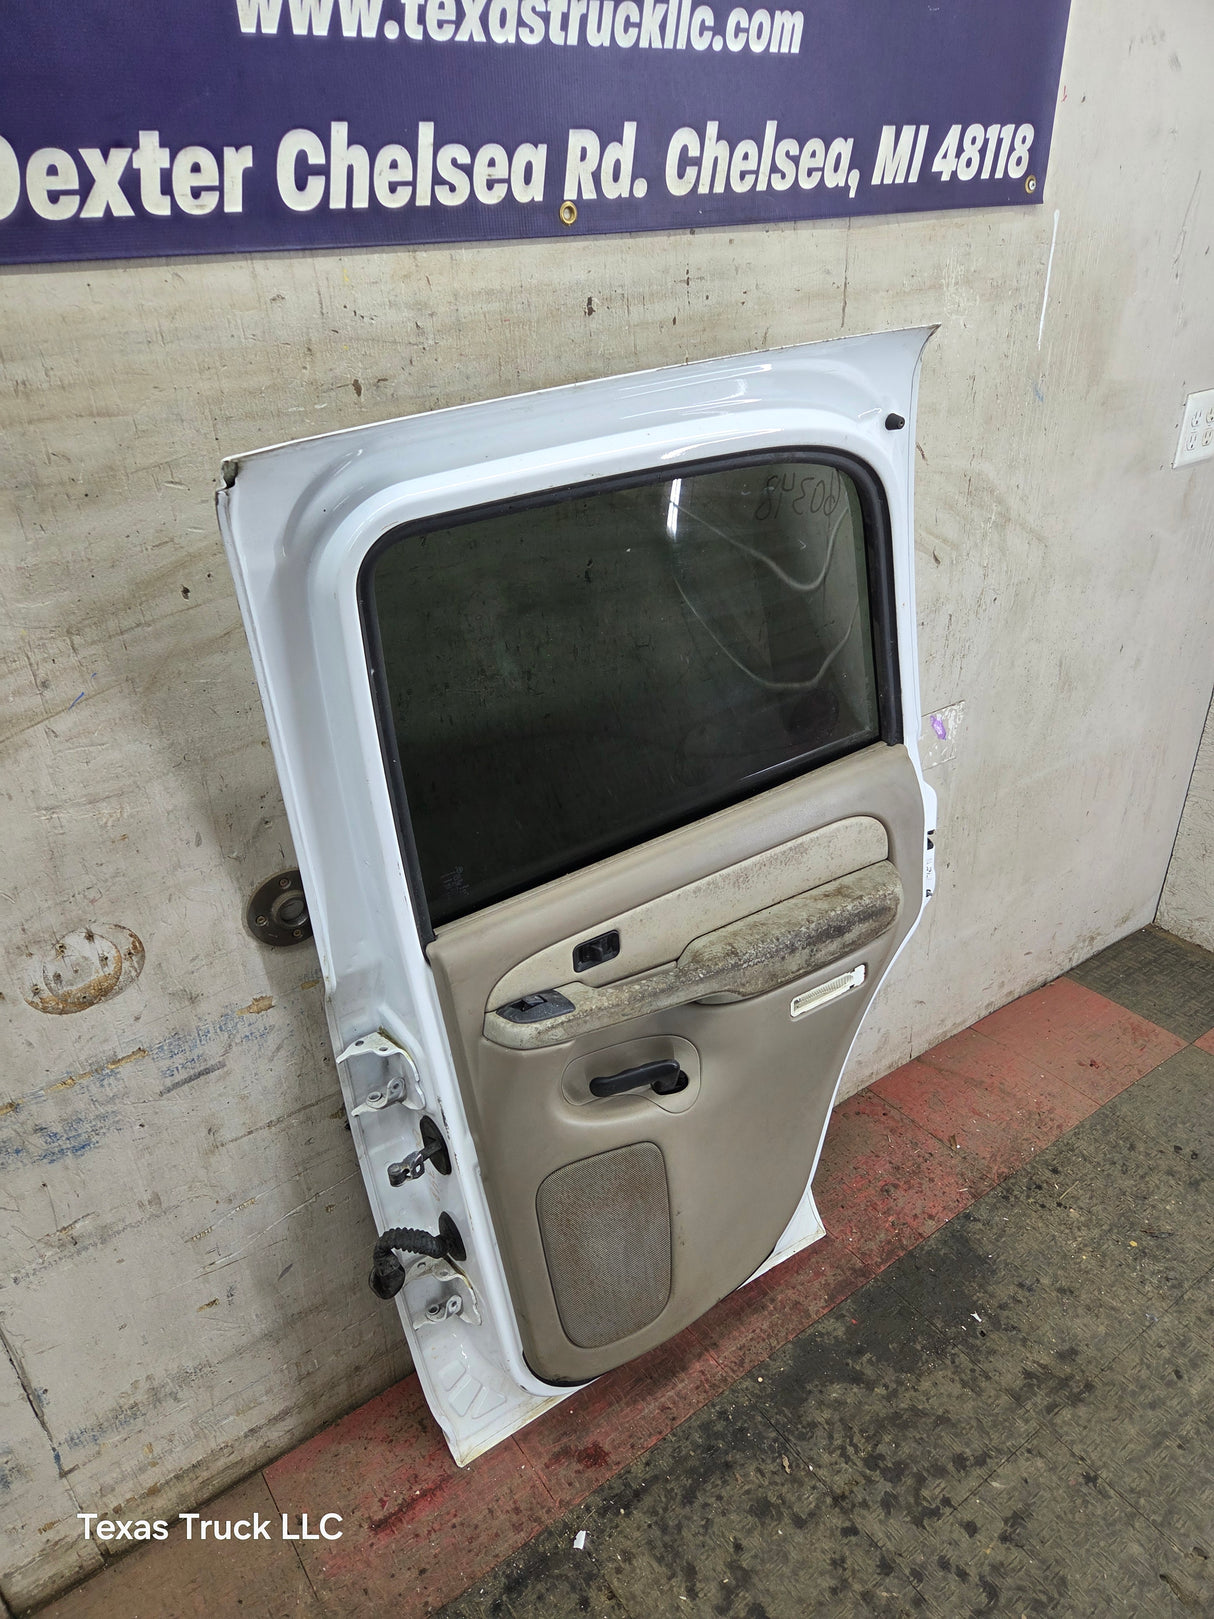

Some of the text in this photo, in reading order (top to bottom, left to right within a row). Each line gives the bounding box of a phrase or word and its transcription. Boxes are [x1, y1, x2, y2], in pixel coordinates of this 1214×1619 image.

[276, 121, 548, 212] Chelsea
[563, 121, 648, 200] Rd.
[665, 120, 861, 199] Chelsea,
[870, 125, 930, 186] MI
[931, 123, 1035, 182] 48118
